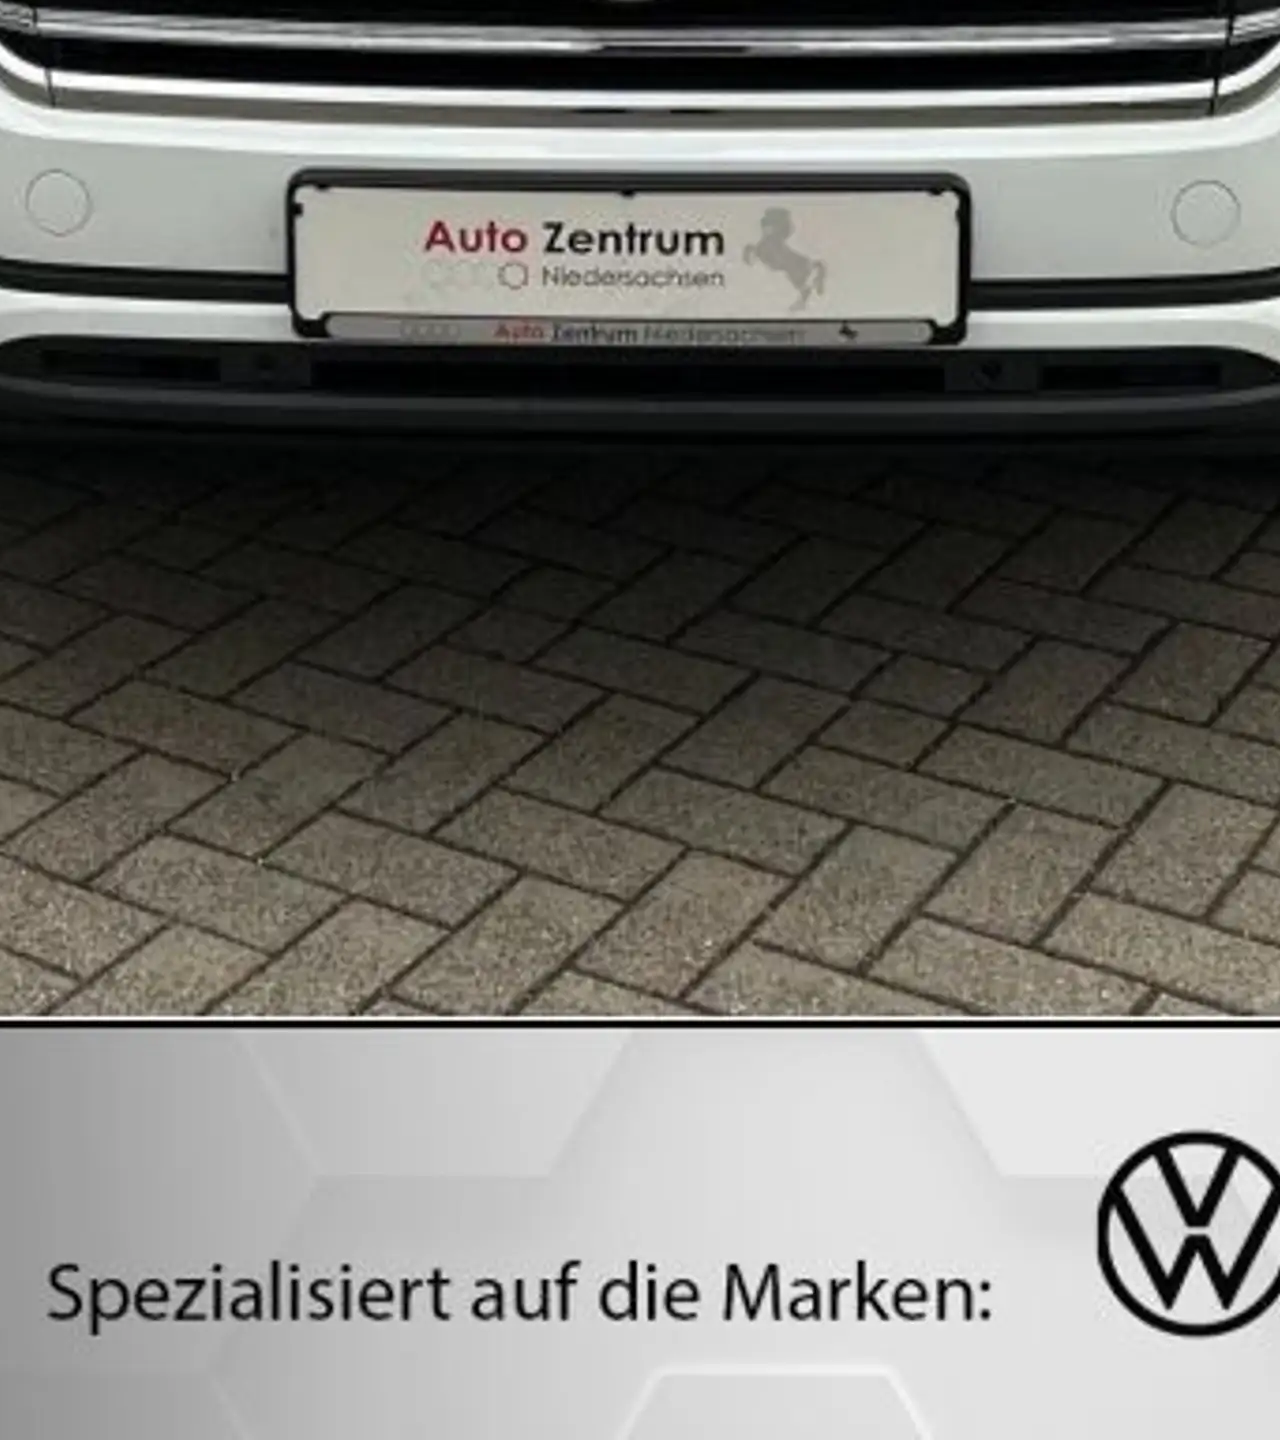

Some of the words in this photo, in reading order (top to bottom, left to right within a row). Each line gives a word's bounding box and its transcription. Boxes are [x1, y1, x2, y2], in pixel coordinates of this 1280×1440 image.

[425, 221, 528, 253] Auto
[543, 222, 725, 256] Zentrum
[542, 265, 725, 288] Niedersachsen
[493, 322, 544, 339] Auto
[552, 323, 638, 343] Zentrum
